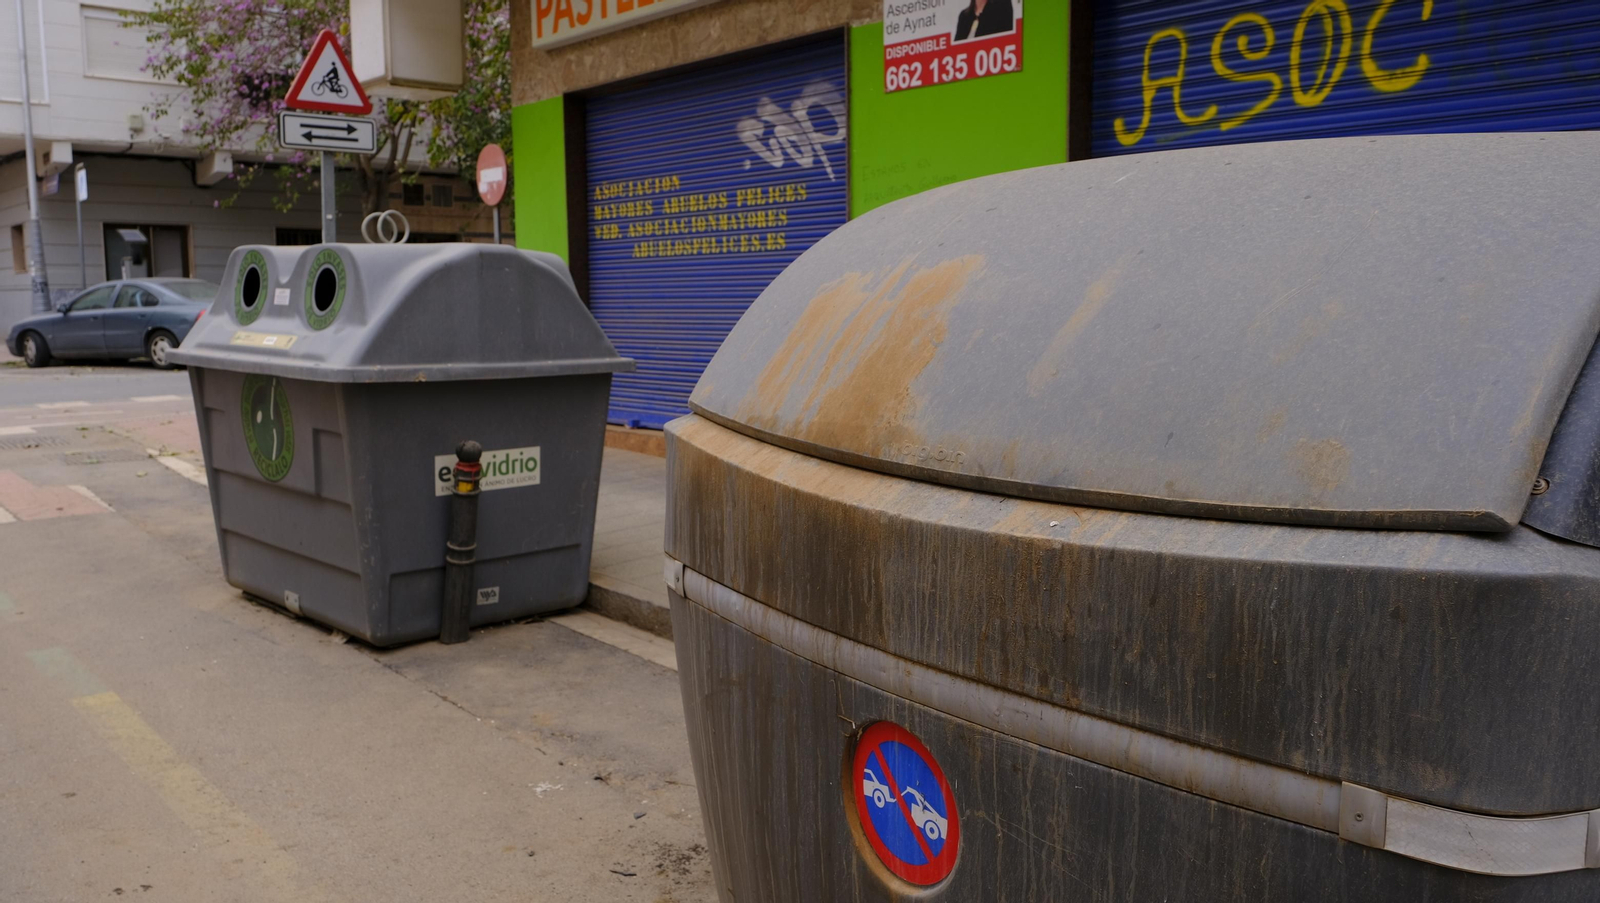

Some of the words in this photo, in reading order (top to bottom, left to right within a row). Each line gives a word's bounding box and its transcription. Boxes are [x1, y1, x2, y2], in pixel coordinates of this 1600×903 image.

[886, 23, 900, 36] de
[903, 12, 937, 33] Aynat
[886, 37, 947, 60] DISPONIBLE
[886, 61, 922, 91] 662
[929, 53, 968, 83] 135
[974, 44, 1017, 76] 005
[1113, 0, 1434, 147] ASOC
[593, 175, 681, 200] ASOCIACION
[736, 183, 807, 207] FELICES
[438, 451, 538, 483] evidrio
